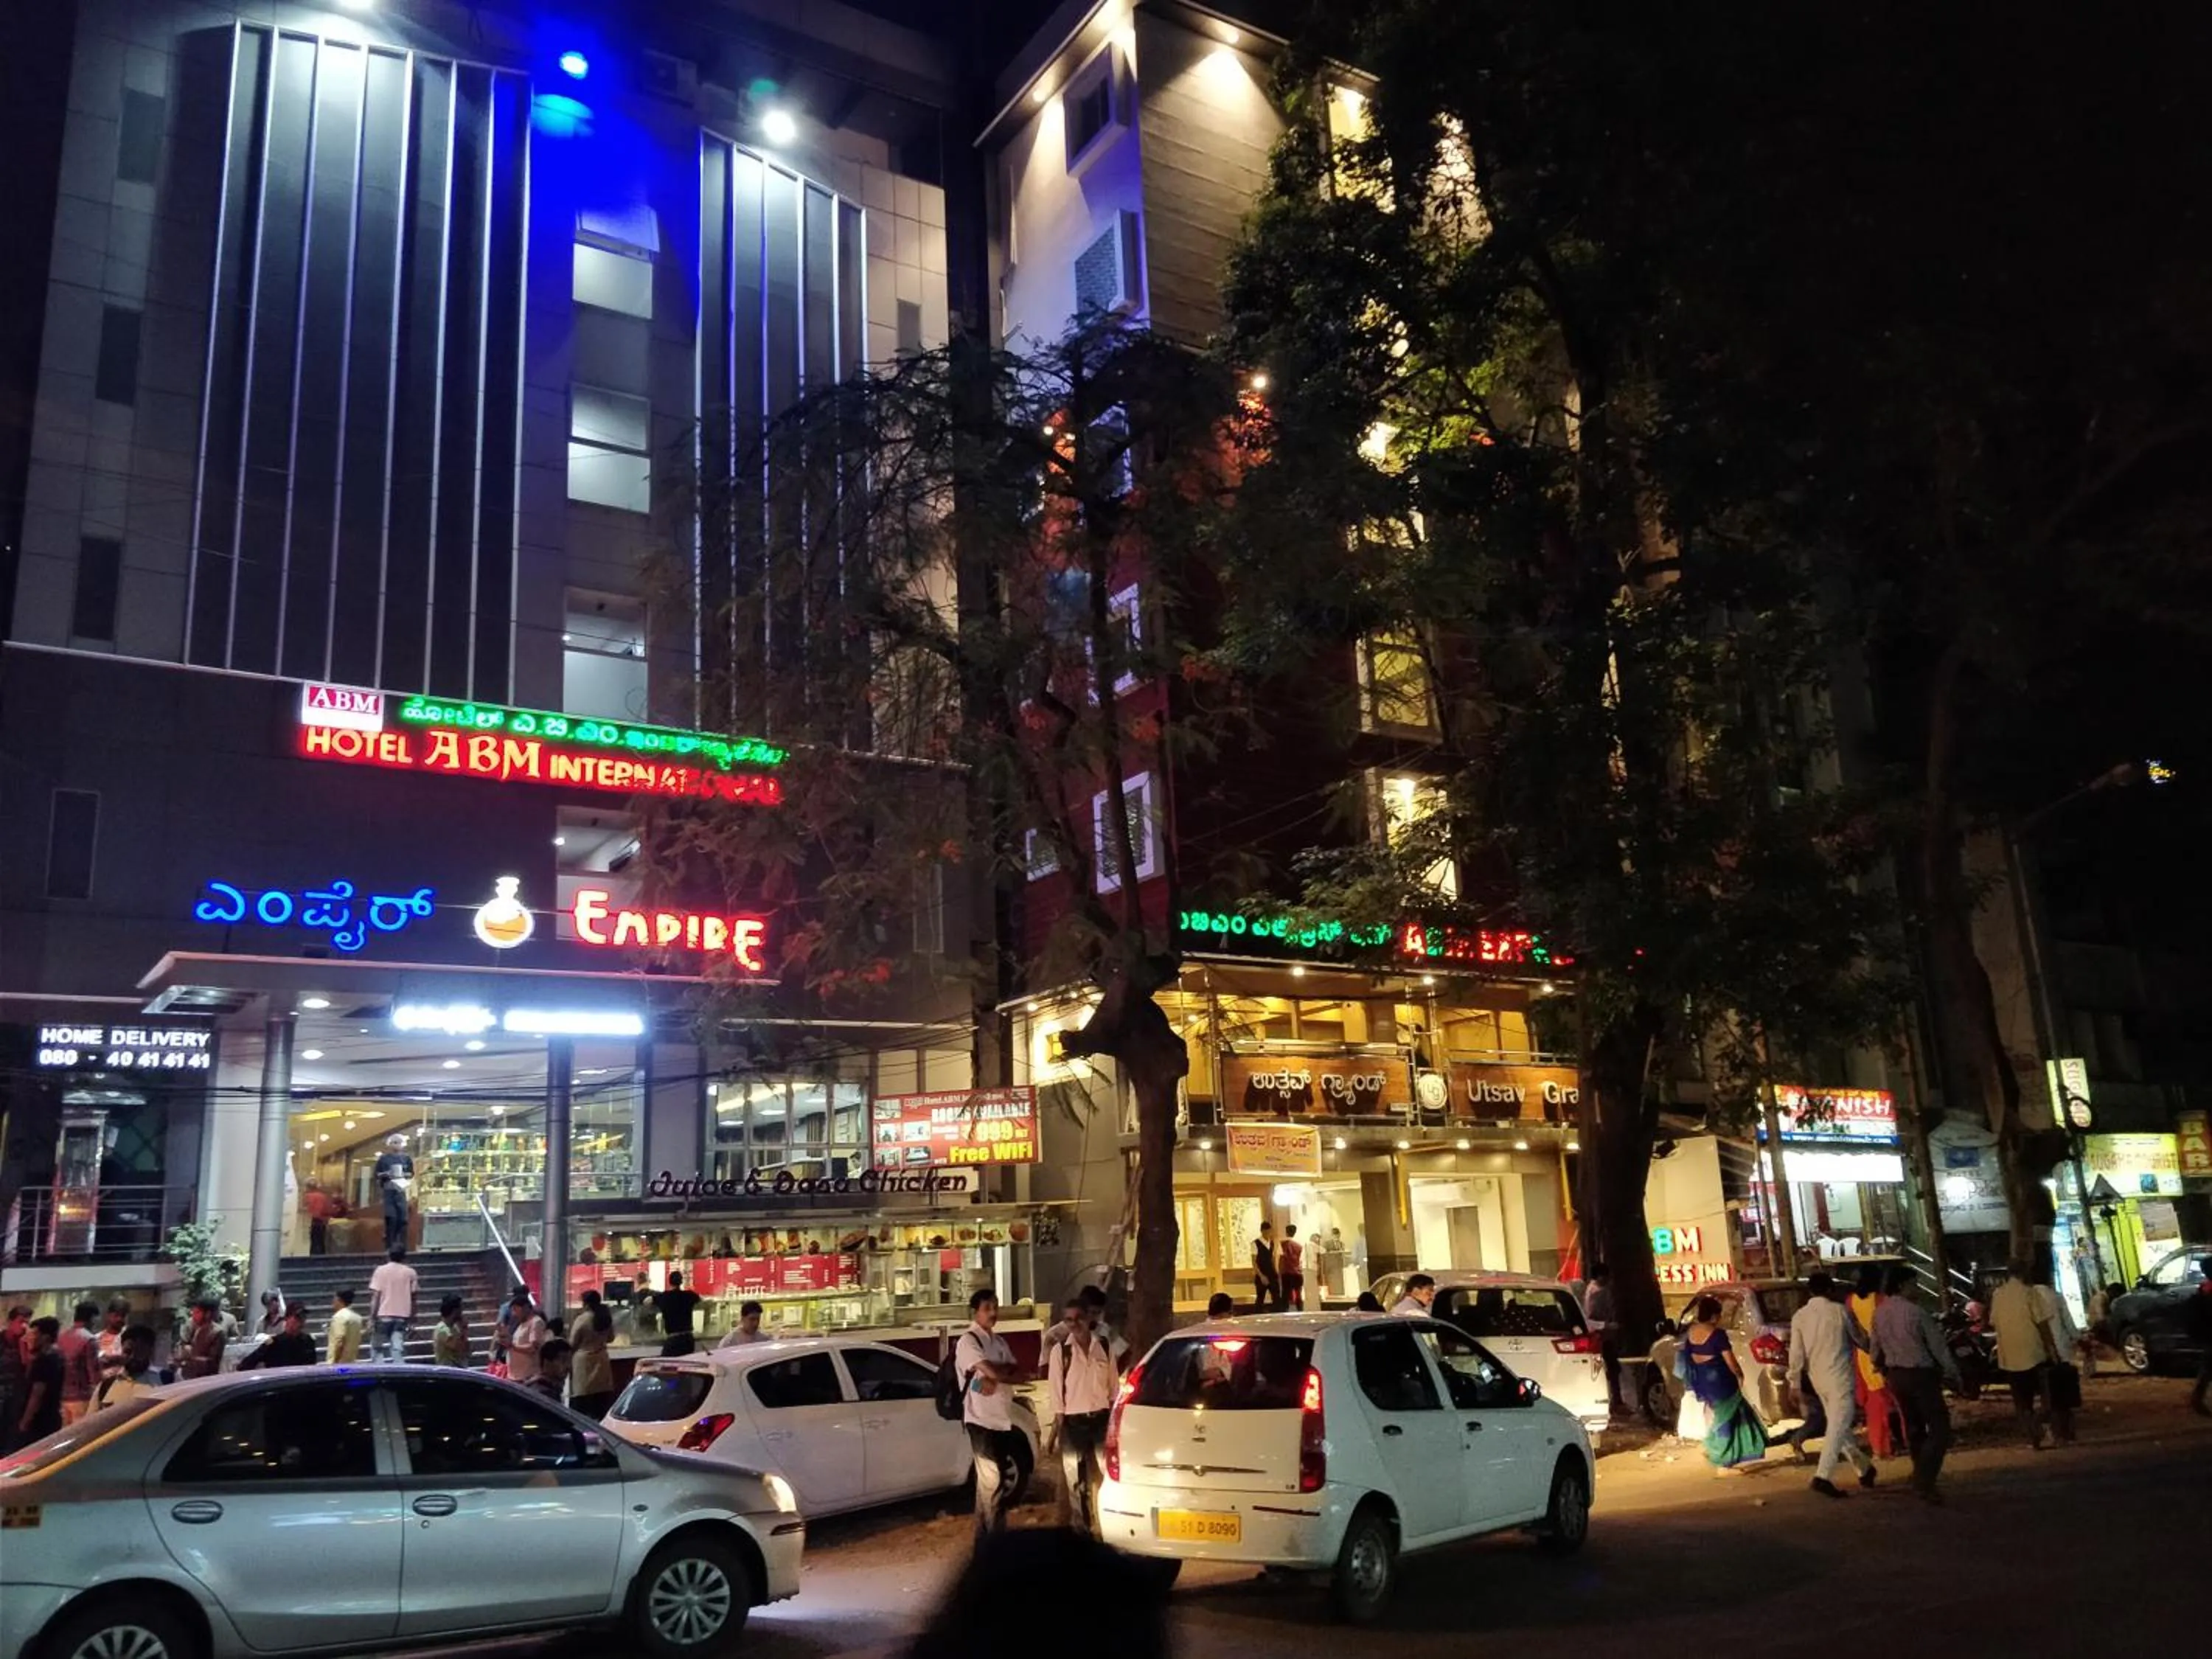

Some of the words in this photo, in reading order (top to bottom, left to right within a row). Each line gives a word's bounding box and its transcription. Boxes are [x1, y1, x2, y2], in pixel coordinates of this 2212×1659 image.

[311, 687, 377, 714] ABM
[306, 726, 413, 764] HOTEL
[424, 730, 543, 779] ABM
[195, 880, 434, 951] ಎಂಪೈರ್
[573, 889, 765, 972] EMPIRE
[41, 1028, 102, 1045] HOME
[111, 1029, 211, 1047] DELIVERY
[1467, 1079, 1526, 1103] Utsav
[1544, 1080, 1579, 1104] Gra
[949, 1145, 990, 1163] Free
[2182, 1121, 2209, 1169] BAR
[859, 1167, 968, 1193] Chicken
[1652, 1226, 1700, 1253] BM
[1697, 1262, 1730, 1282] INN
